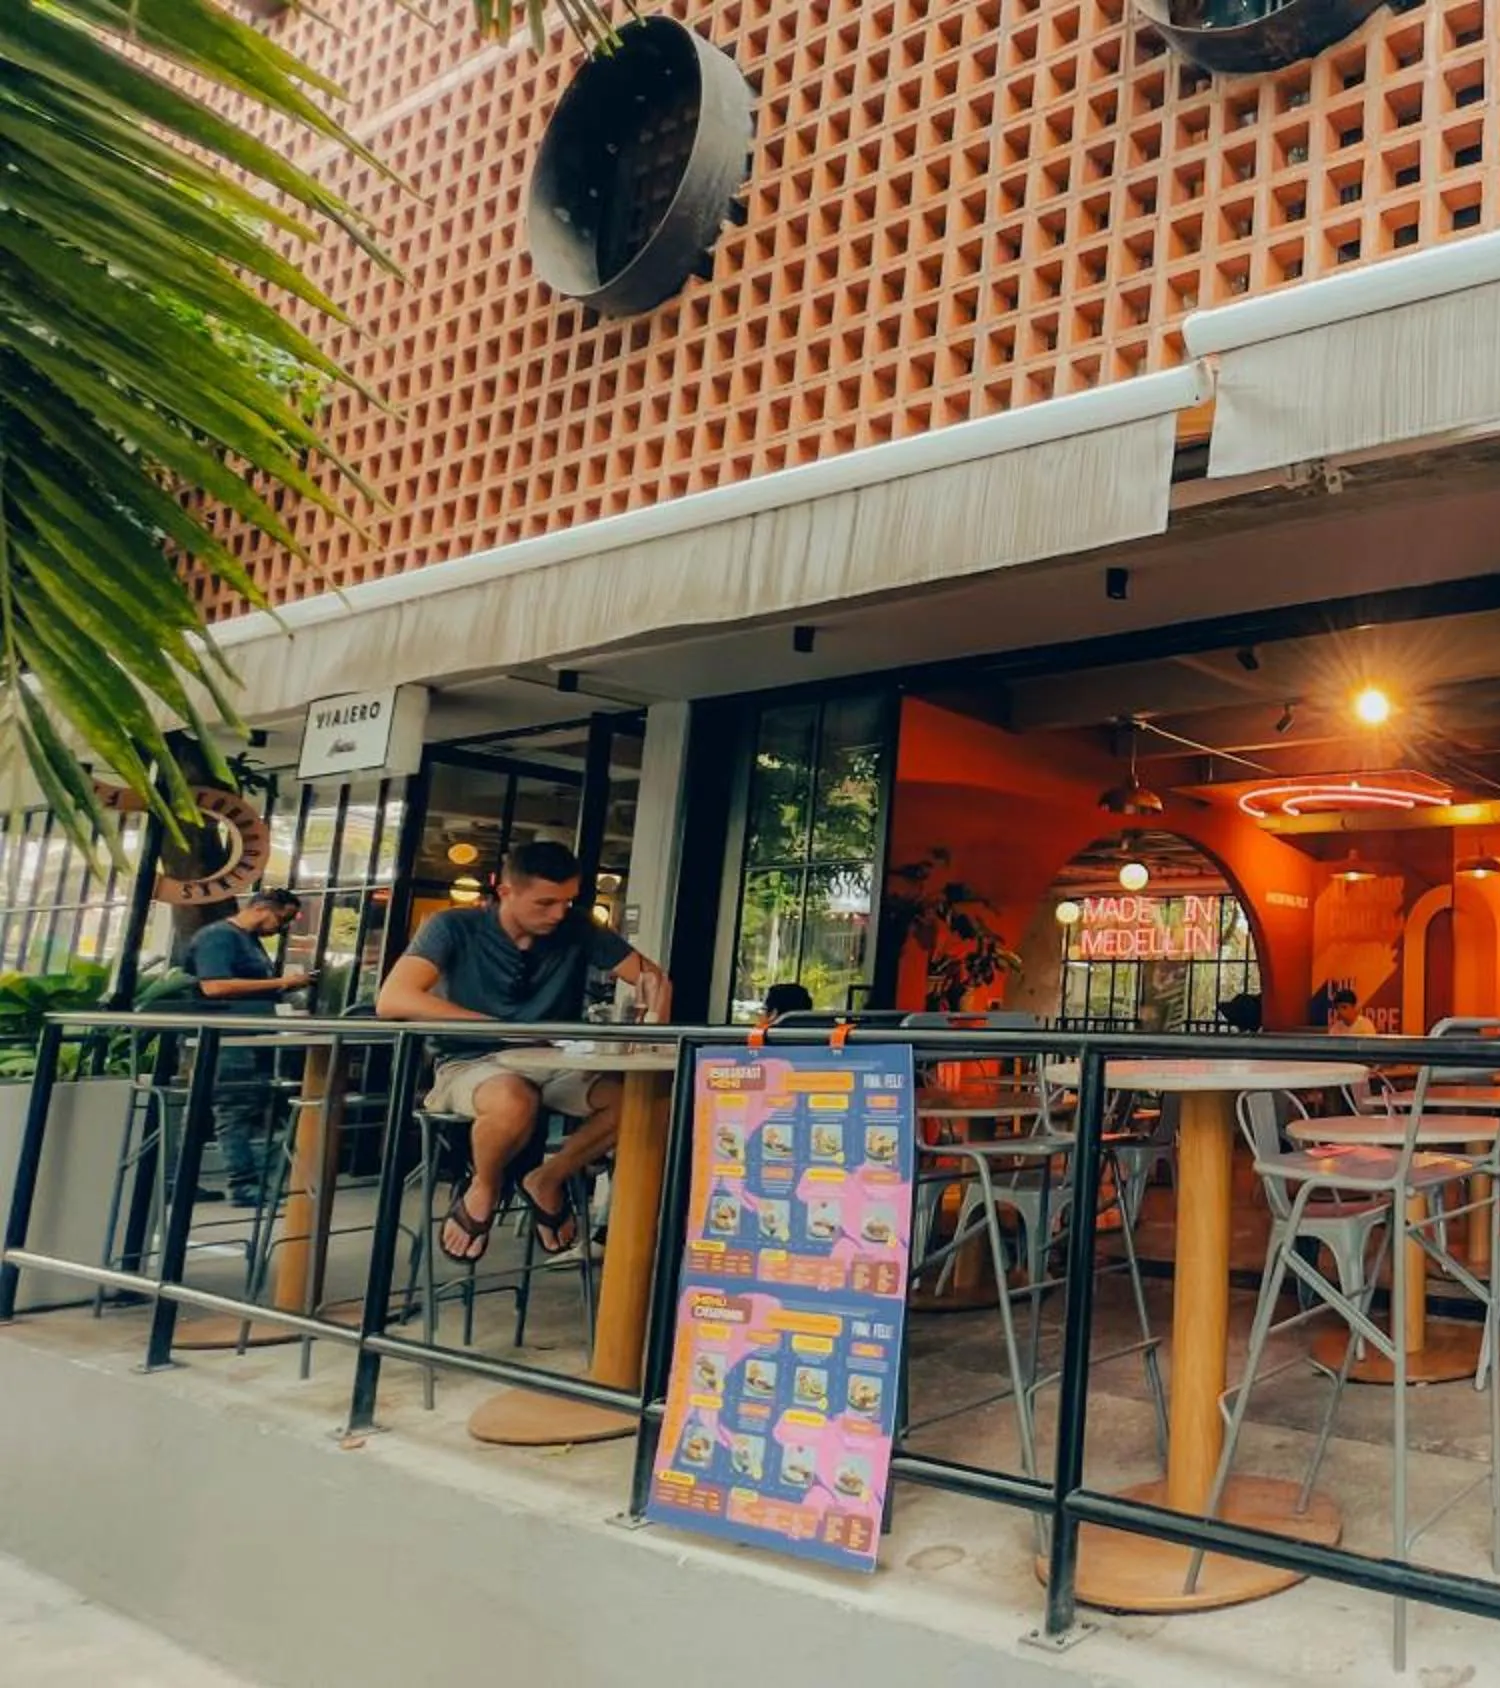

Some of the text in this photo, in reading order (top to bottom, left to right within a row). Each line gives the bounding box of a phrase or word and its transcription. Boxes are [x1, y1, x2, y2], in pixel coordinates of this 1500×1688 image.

[316, 701, 381, 730] VIAJERO
[1083, 895, 1214, 923] MADE IN
